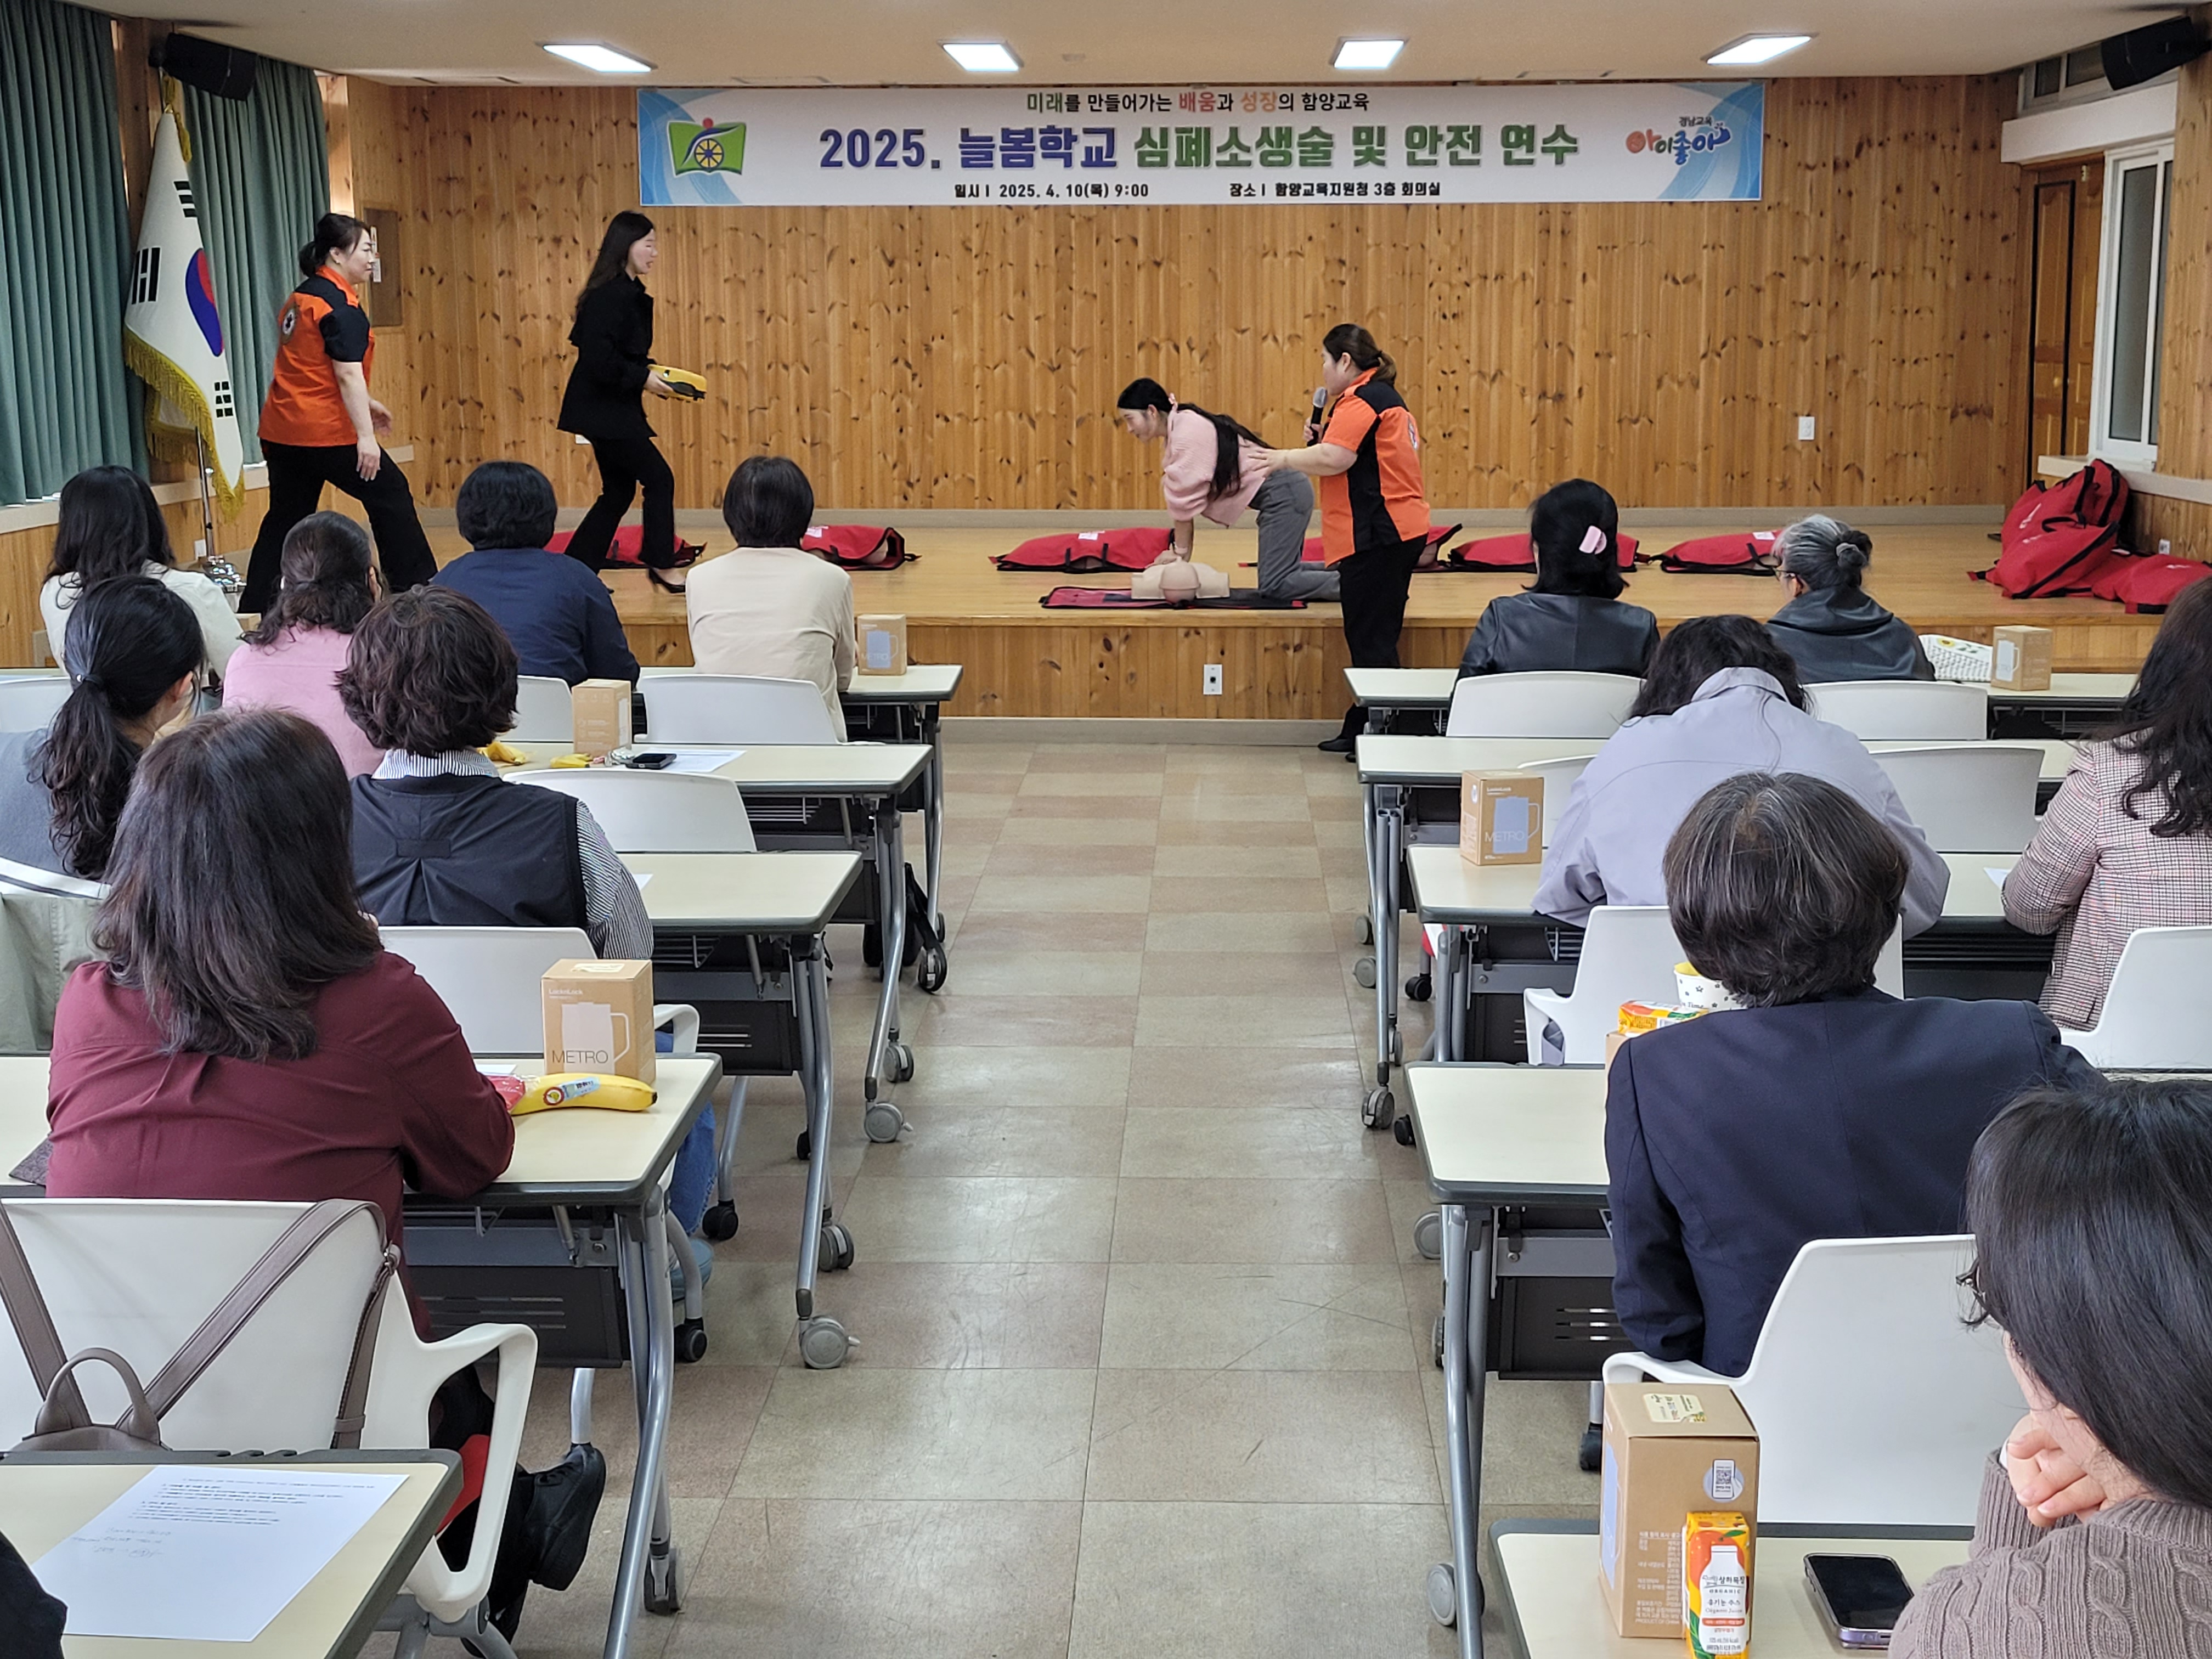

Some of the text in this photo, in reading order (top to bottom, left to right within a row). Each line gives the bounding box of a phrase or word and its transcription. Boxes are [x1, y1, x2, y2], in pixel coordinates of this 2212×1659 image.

[1027, 91, 1370, 113] 미래를 만들어가는 배움과 성장의 함양교육
[1679, 116, 1712, 127] 경남교육
[820, 123, 1579, 169] 2025. 늘봄학교 심폐소생술 및 안전 연수
[1626, 127, 1731, 165] 아이좋아
[954, 184, 980, 198] 일시
[999, 184, 1041, 198] 2025.
[1046, 184, 1060, 198] 4.
[1066, 183, 1109, 199] 10(목)
[1115, 184, 1149, 198] 9:00
[1229, 183, 1257, 197] 장소
[1274, 182, 1369, 197] 함양교육지원청
[1374, 182, 1396, 196] 3층
[1401, 182, 1441, 196] 회의실
[1484, 830, 1525, 843] METRO
[552, 1049, 608, 1064] METRO
[1719, 1576, 1745, 1585] 상하목장
